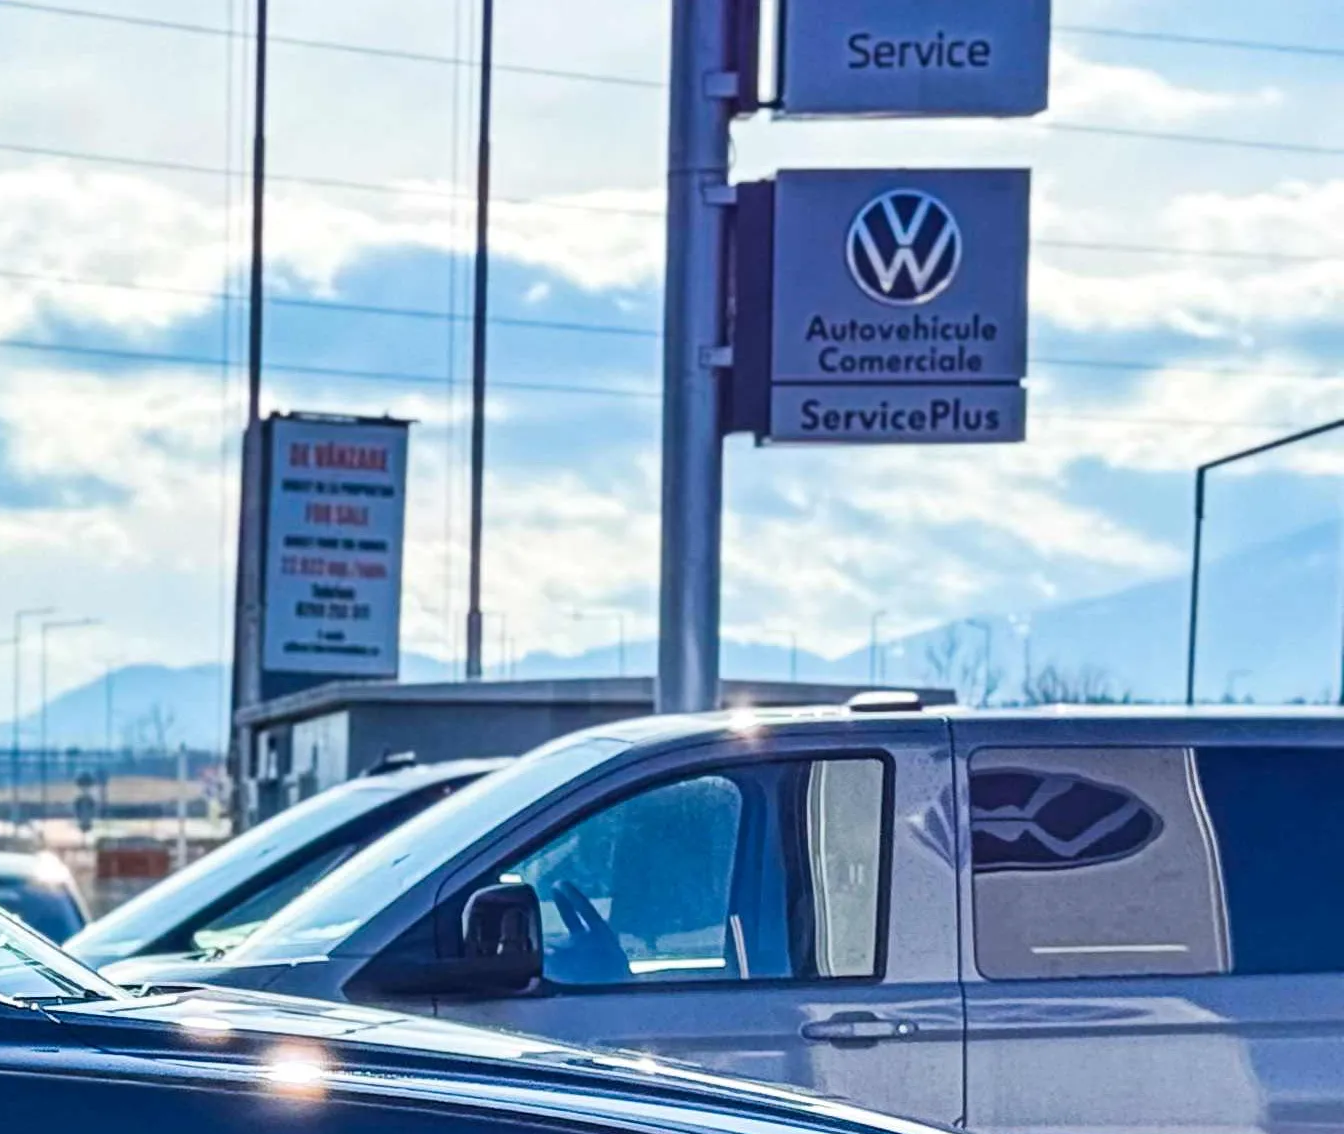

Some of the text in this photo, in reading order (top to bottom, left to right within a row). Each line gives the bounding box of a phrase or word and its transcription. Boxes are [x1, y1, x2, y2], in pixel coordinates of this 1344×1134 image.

[847, 32, 991, 69] Service
[805, 314, 998, 342] Autovehicule
[818, 346, 983, 373] Comerciale
[800, 400, 1000, 432] ServicePlus
